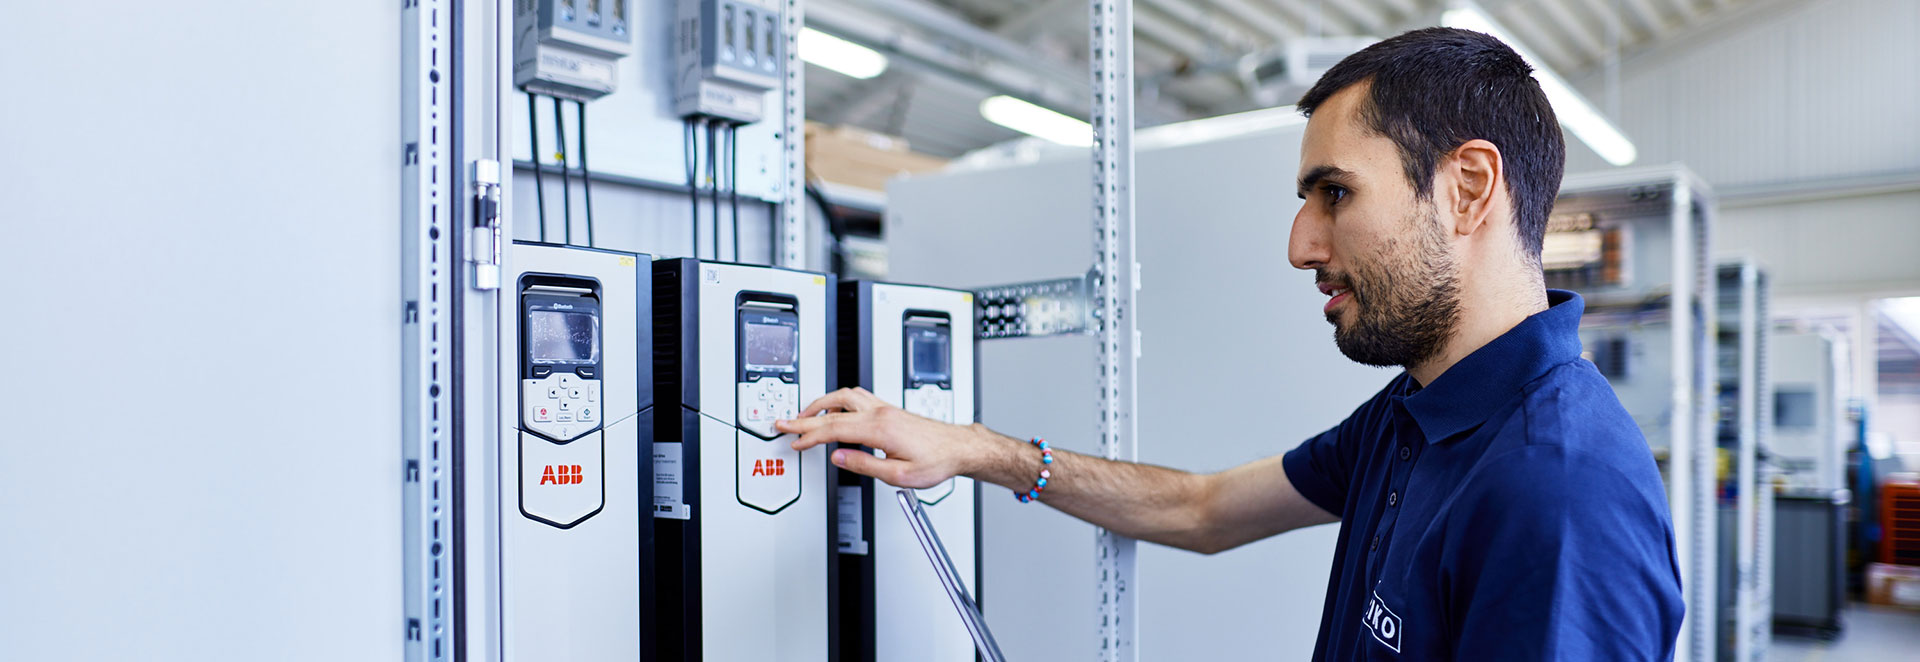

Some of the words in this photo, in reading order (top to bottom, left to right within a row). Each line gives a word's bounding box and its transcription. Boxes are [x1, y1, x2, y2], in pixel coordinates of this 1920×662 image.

[539, 464, 583, 485] ABB
[752, 458, 785, 477] ABB
[1365, 598, 1396, 639] IKO
